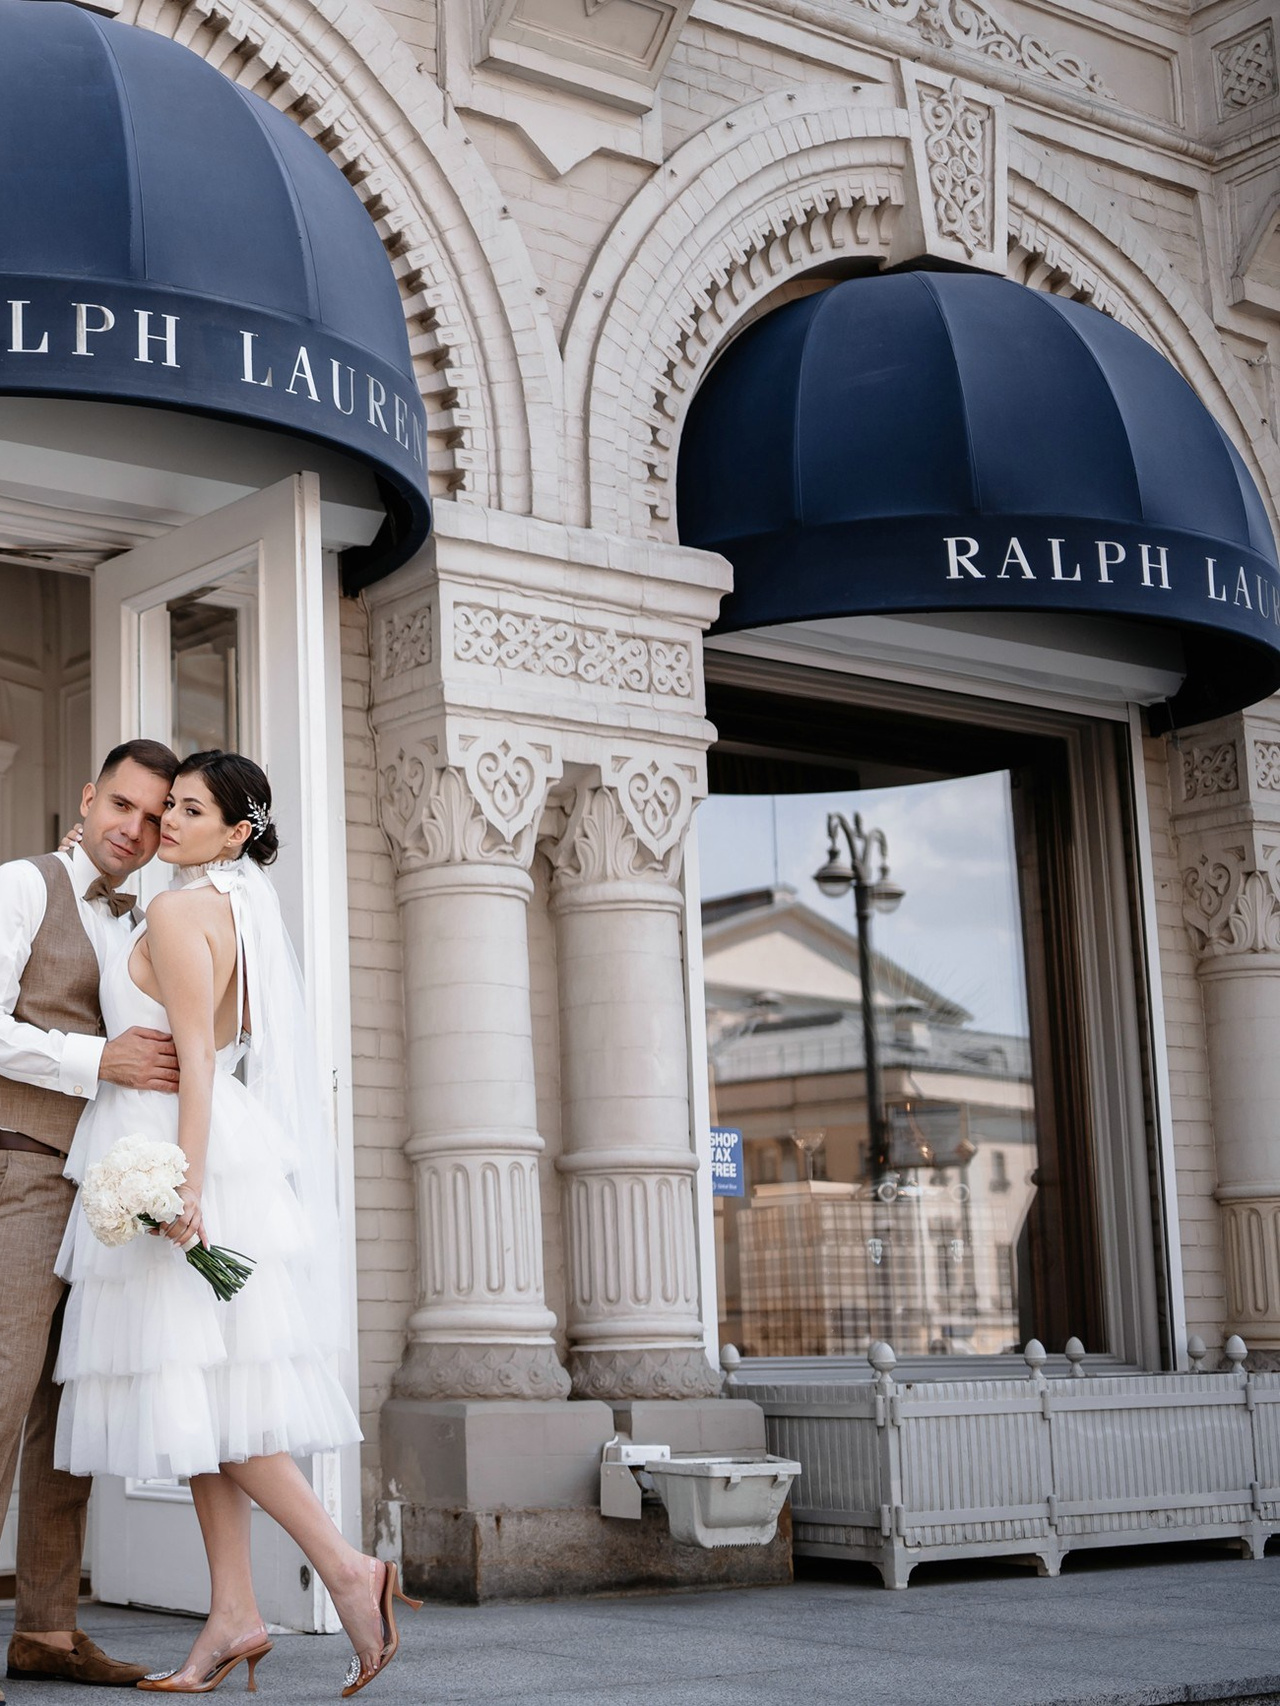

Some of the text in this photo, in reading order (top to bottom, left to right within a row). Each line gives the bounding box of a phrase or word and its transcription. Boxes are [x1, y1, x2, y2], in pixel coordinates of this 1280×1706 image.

[239, 330, 424, 470] LAUREN
[942, 536, 1172, 590] RALPH
[710, 1132, 738, 1148] SHOP
[711, 1147, 732, 1163] TAX
[711, 1162, 737, 1178] FREE
